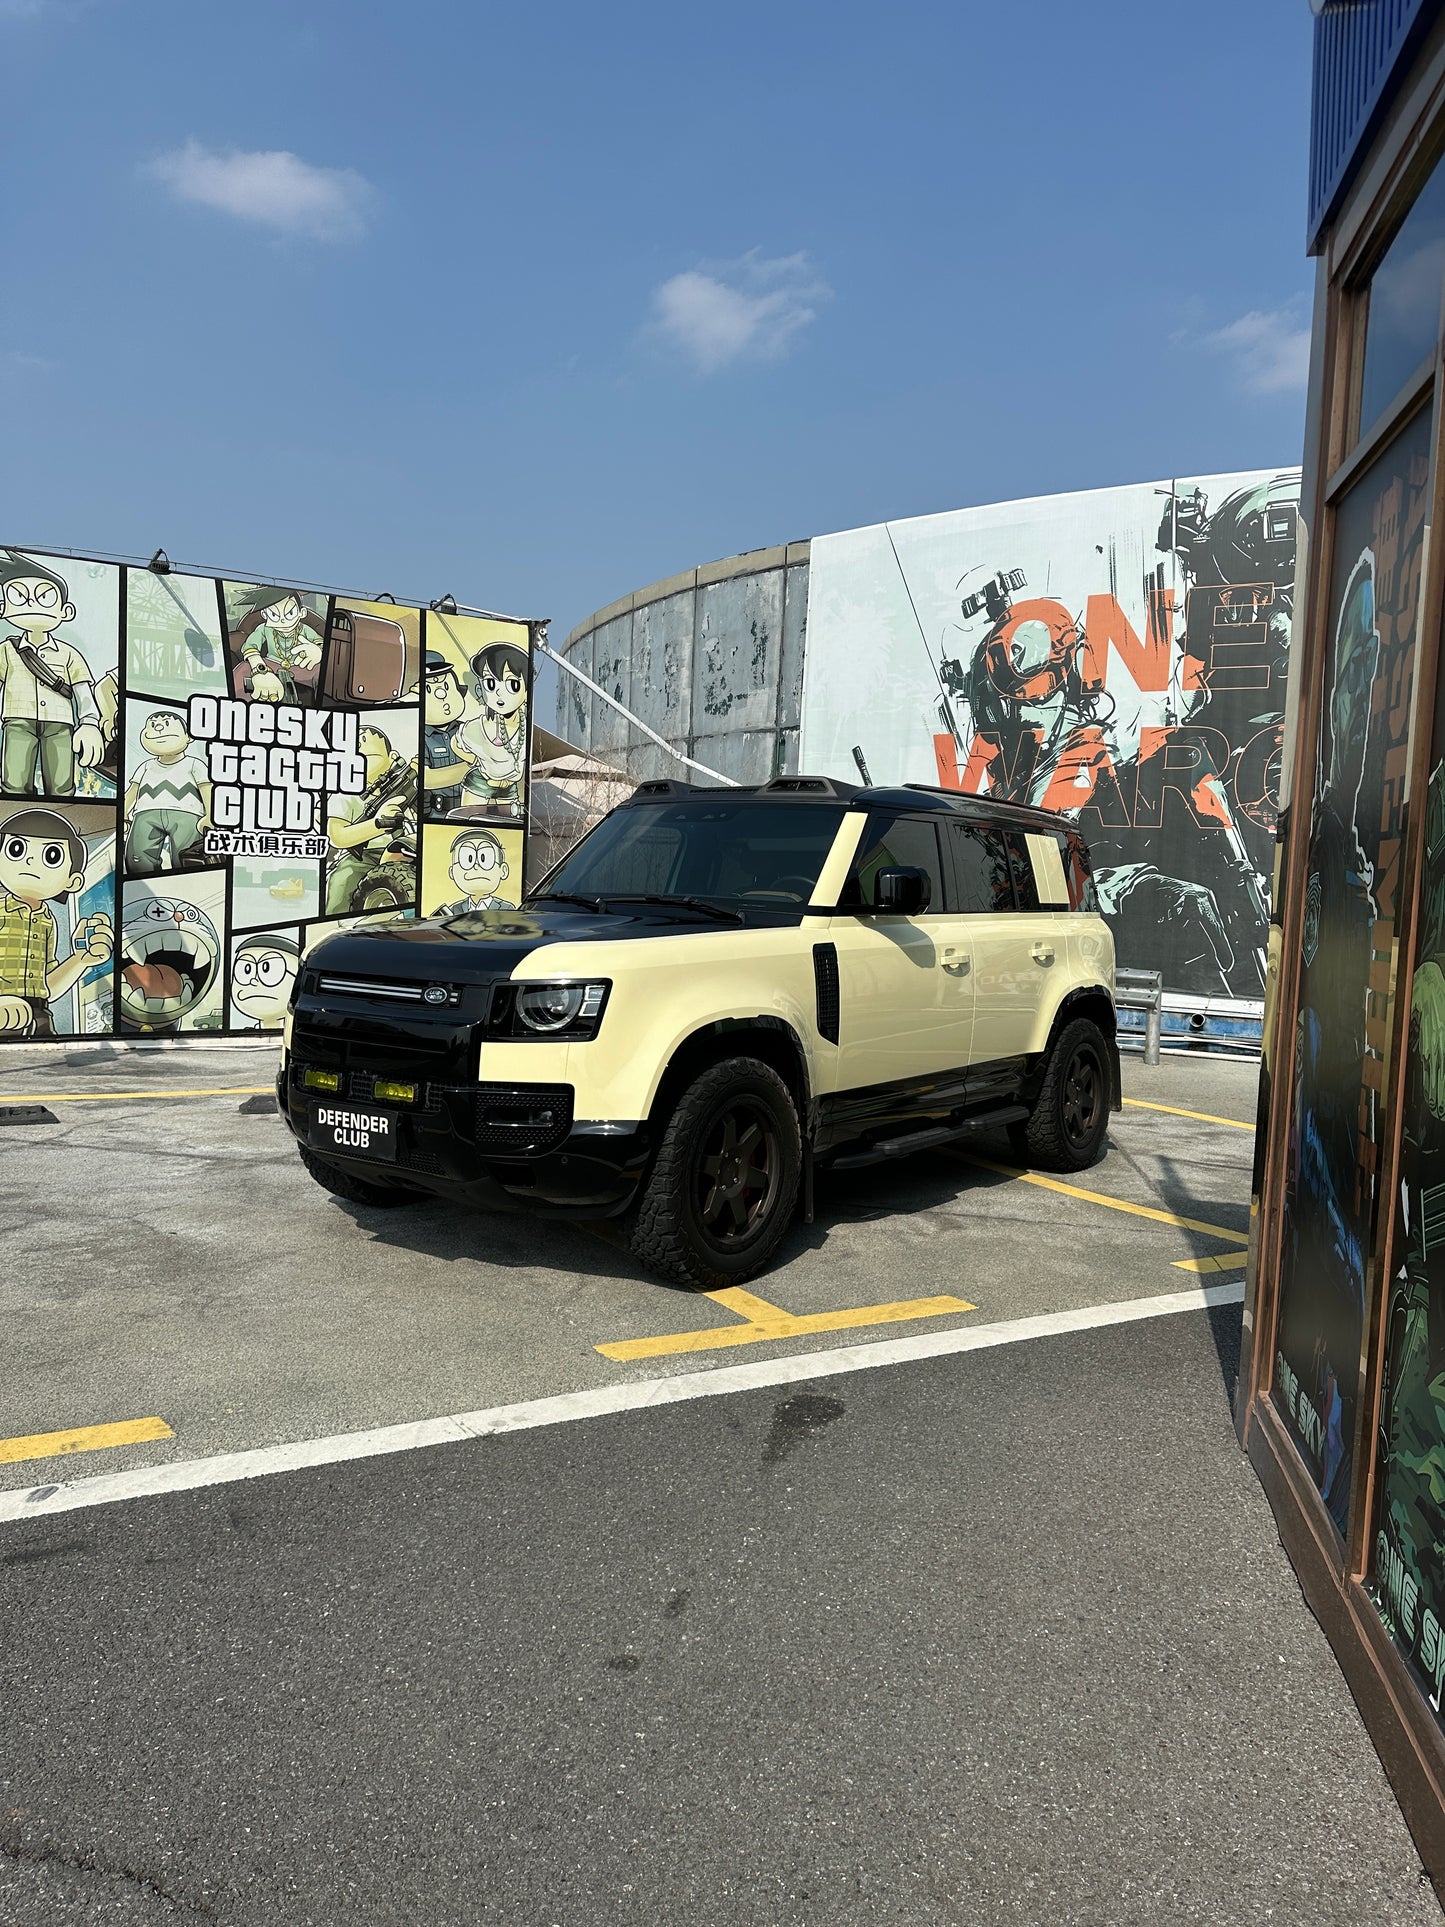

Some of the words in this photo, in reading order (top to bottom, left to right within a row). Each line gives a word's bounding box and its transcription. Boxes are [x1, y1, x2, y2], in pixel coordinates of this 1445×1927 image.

[986, 582, 1274, 699] ONE
[213, 784, 314, 833] club
[206, 833, 329, 857] 战术俱乐部
[318, 1108, 389, 1135] DEFENDER
[333, 1128, 370, 1148] CLUB
[1277, 1350, 1299, 1420] ONE
[1298, 1391, 1327, 1457] SKY
[1376, 1529, 1419, 1643] ONE
